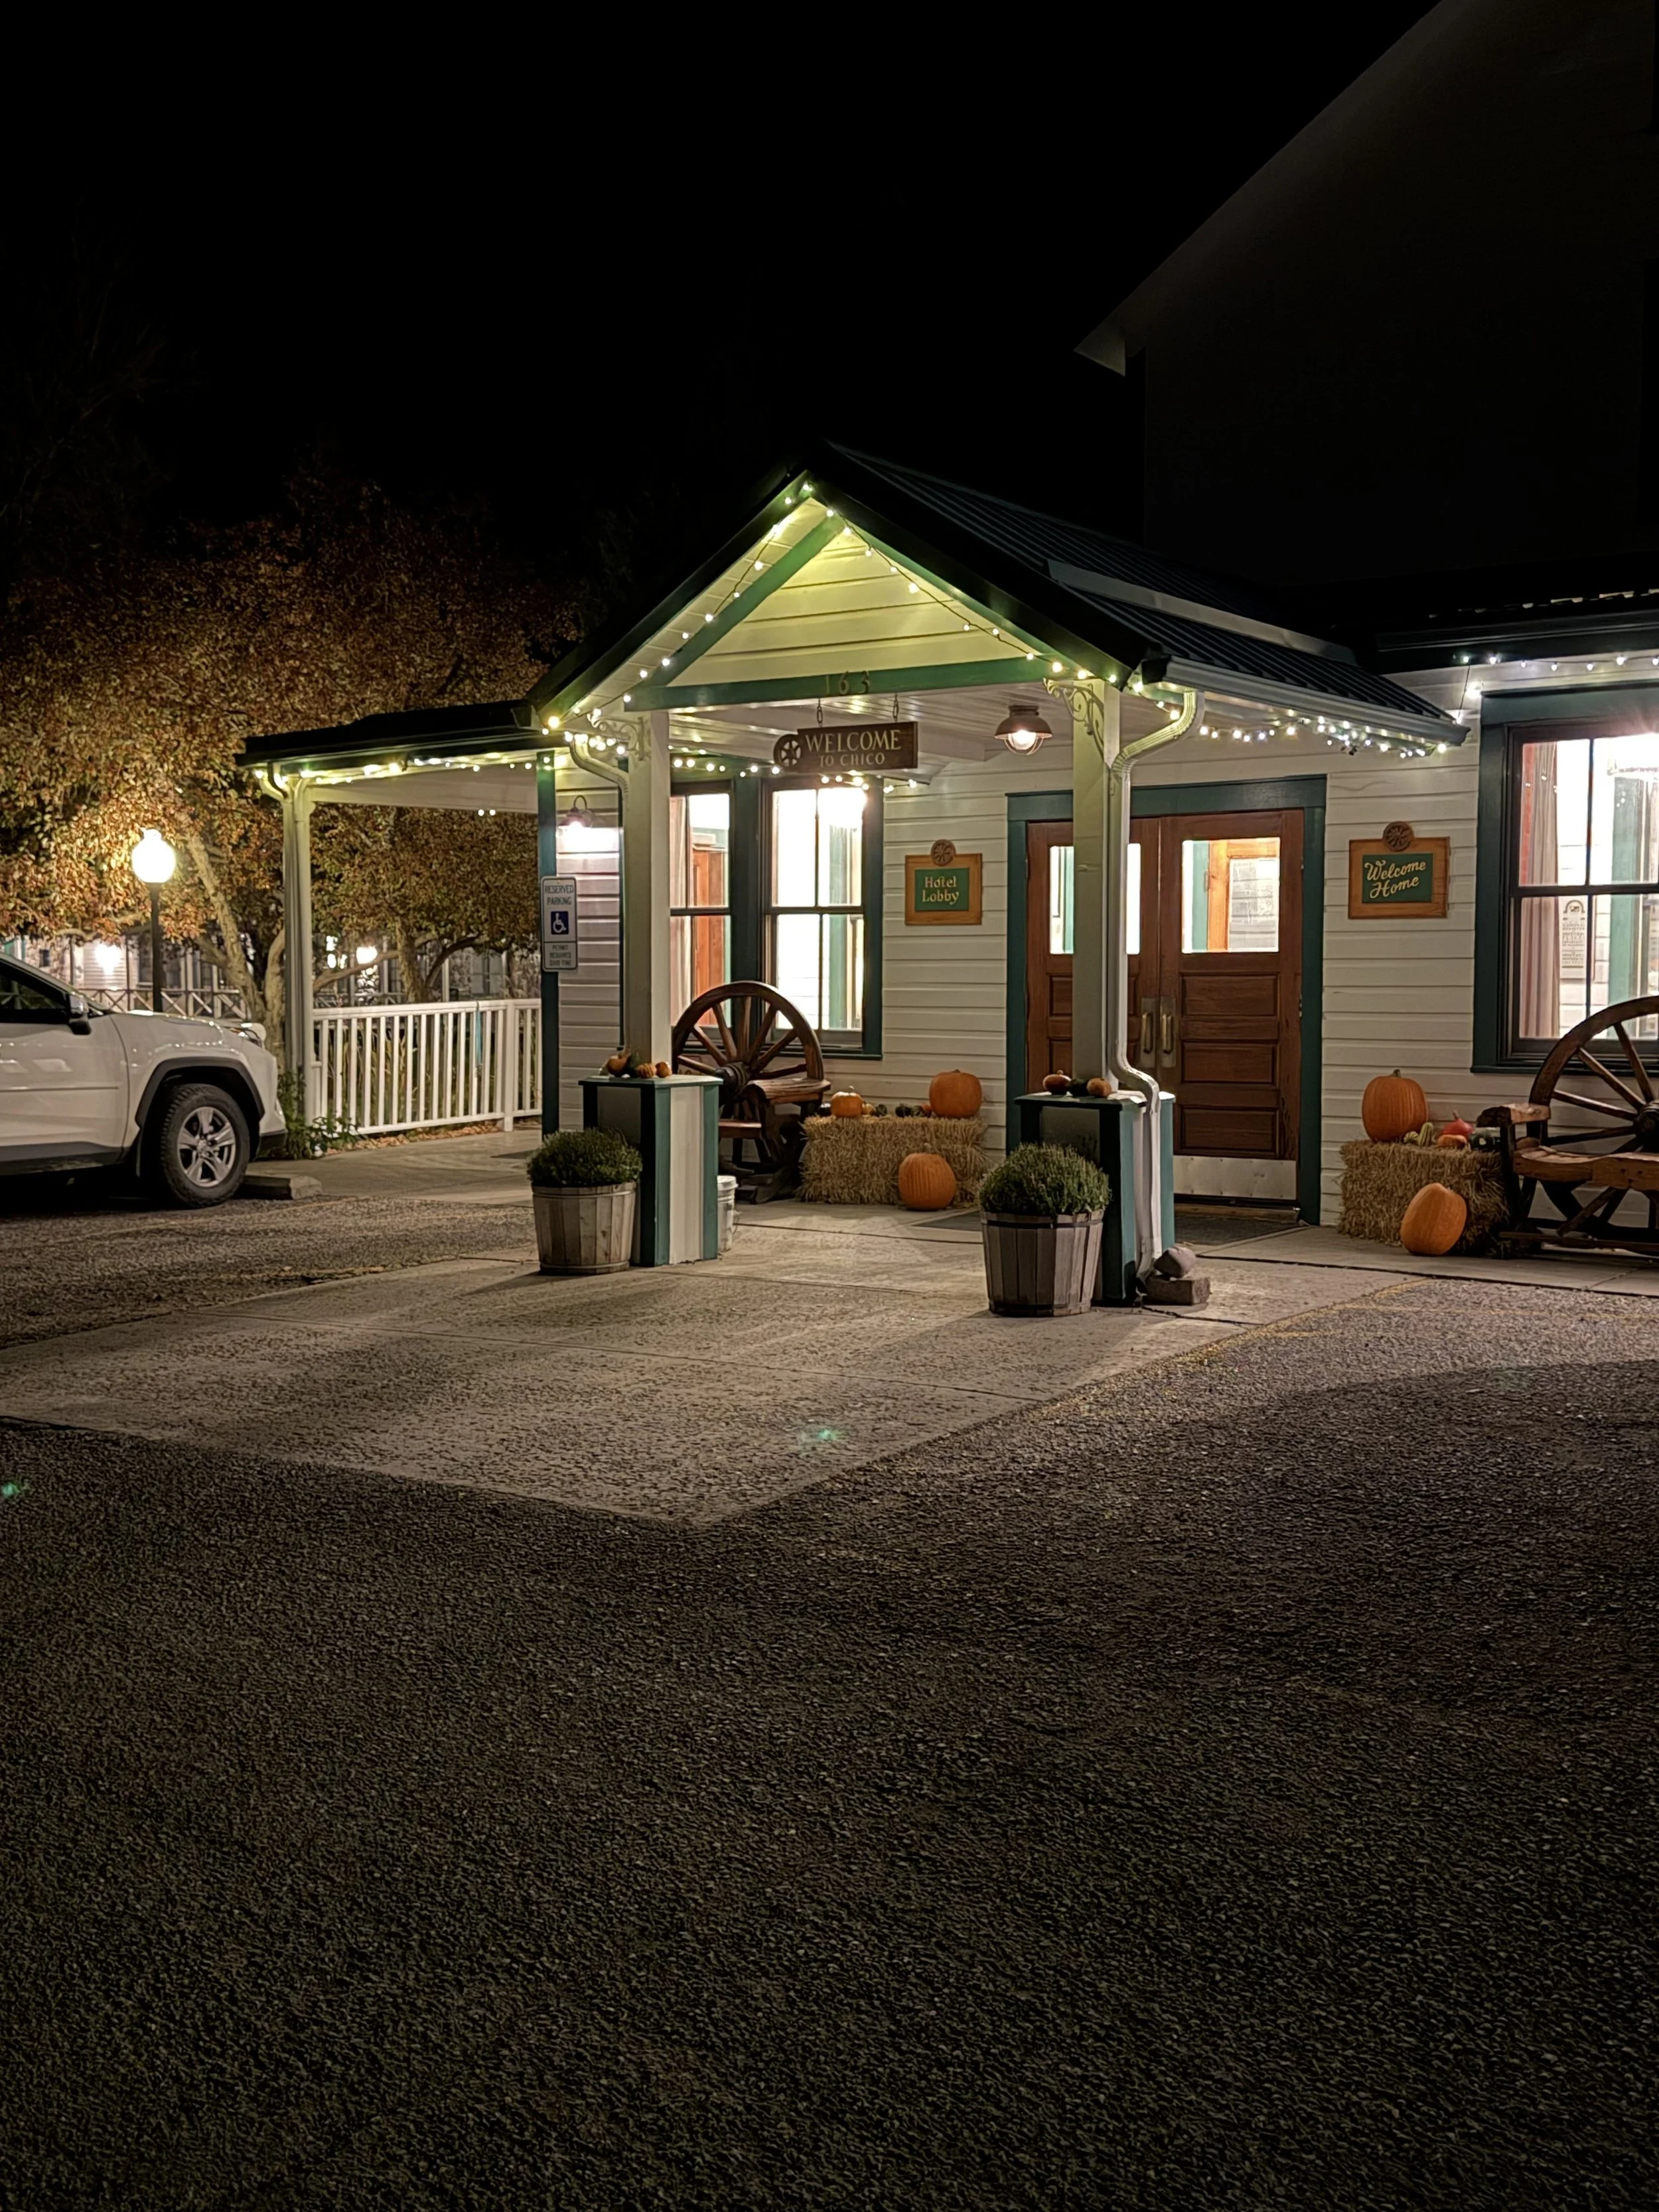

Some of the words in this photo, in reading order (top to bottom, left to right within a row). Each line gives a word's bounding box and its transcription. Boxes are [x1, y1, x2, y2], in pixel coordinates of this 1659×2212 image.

[805, 729, 902, 753] WELCOME
[820, 754, 833, 767] TO
[840, 753, 885, 767] CHICO
[1364, 859, 1426, 881] Welcome
[545, 885, 573, 894] RESERVED
[925, 876, 957, 888] Hotel
[1370, 877, 1419, 899] Home
[547, 897, 571, 906] PARKING
[922, 889, 959, 905] Lobby
